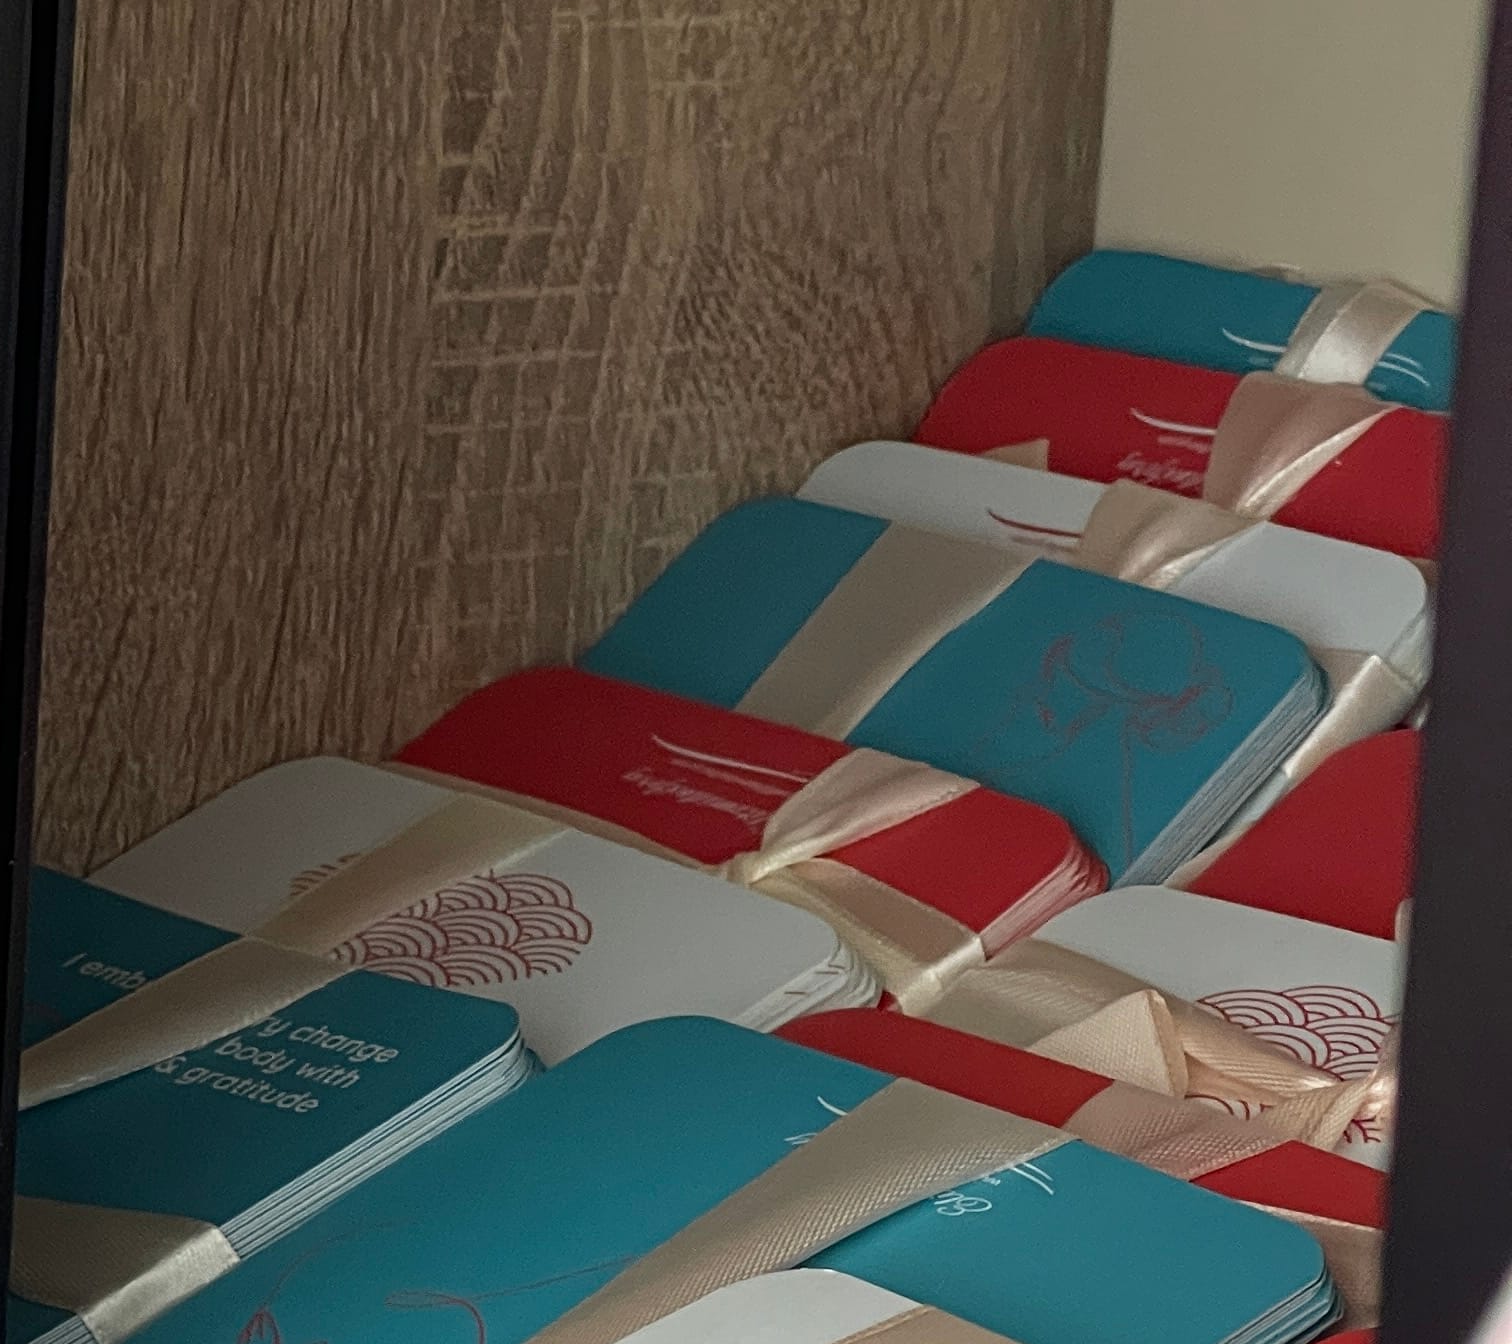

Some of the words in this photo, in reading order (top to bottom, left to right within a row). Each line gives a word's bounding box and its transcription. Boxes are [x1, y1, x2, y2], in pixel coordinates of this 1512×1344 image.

[80, 961, 148, 991] emb
[215, 1037, 292, 1074] body
[296, 1059, 360, 1090] with
[289, 1024, 400, 1064] change
[176, 1065, 320, 1113] gratitude
